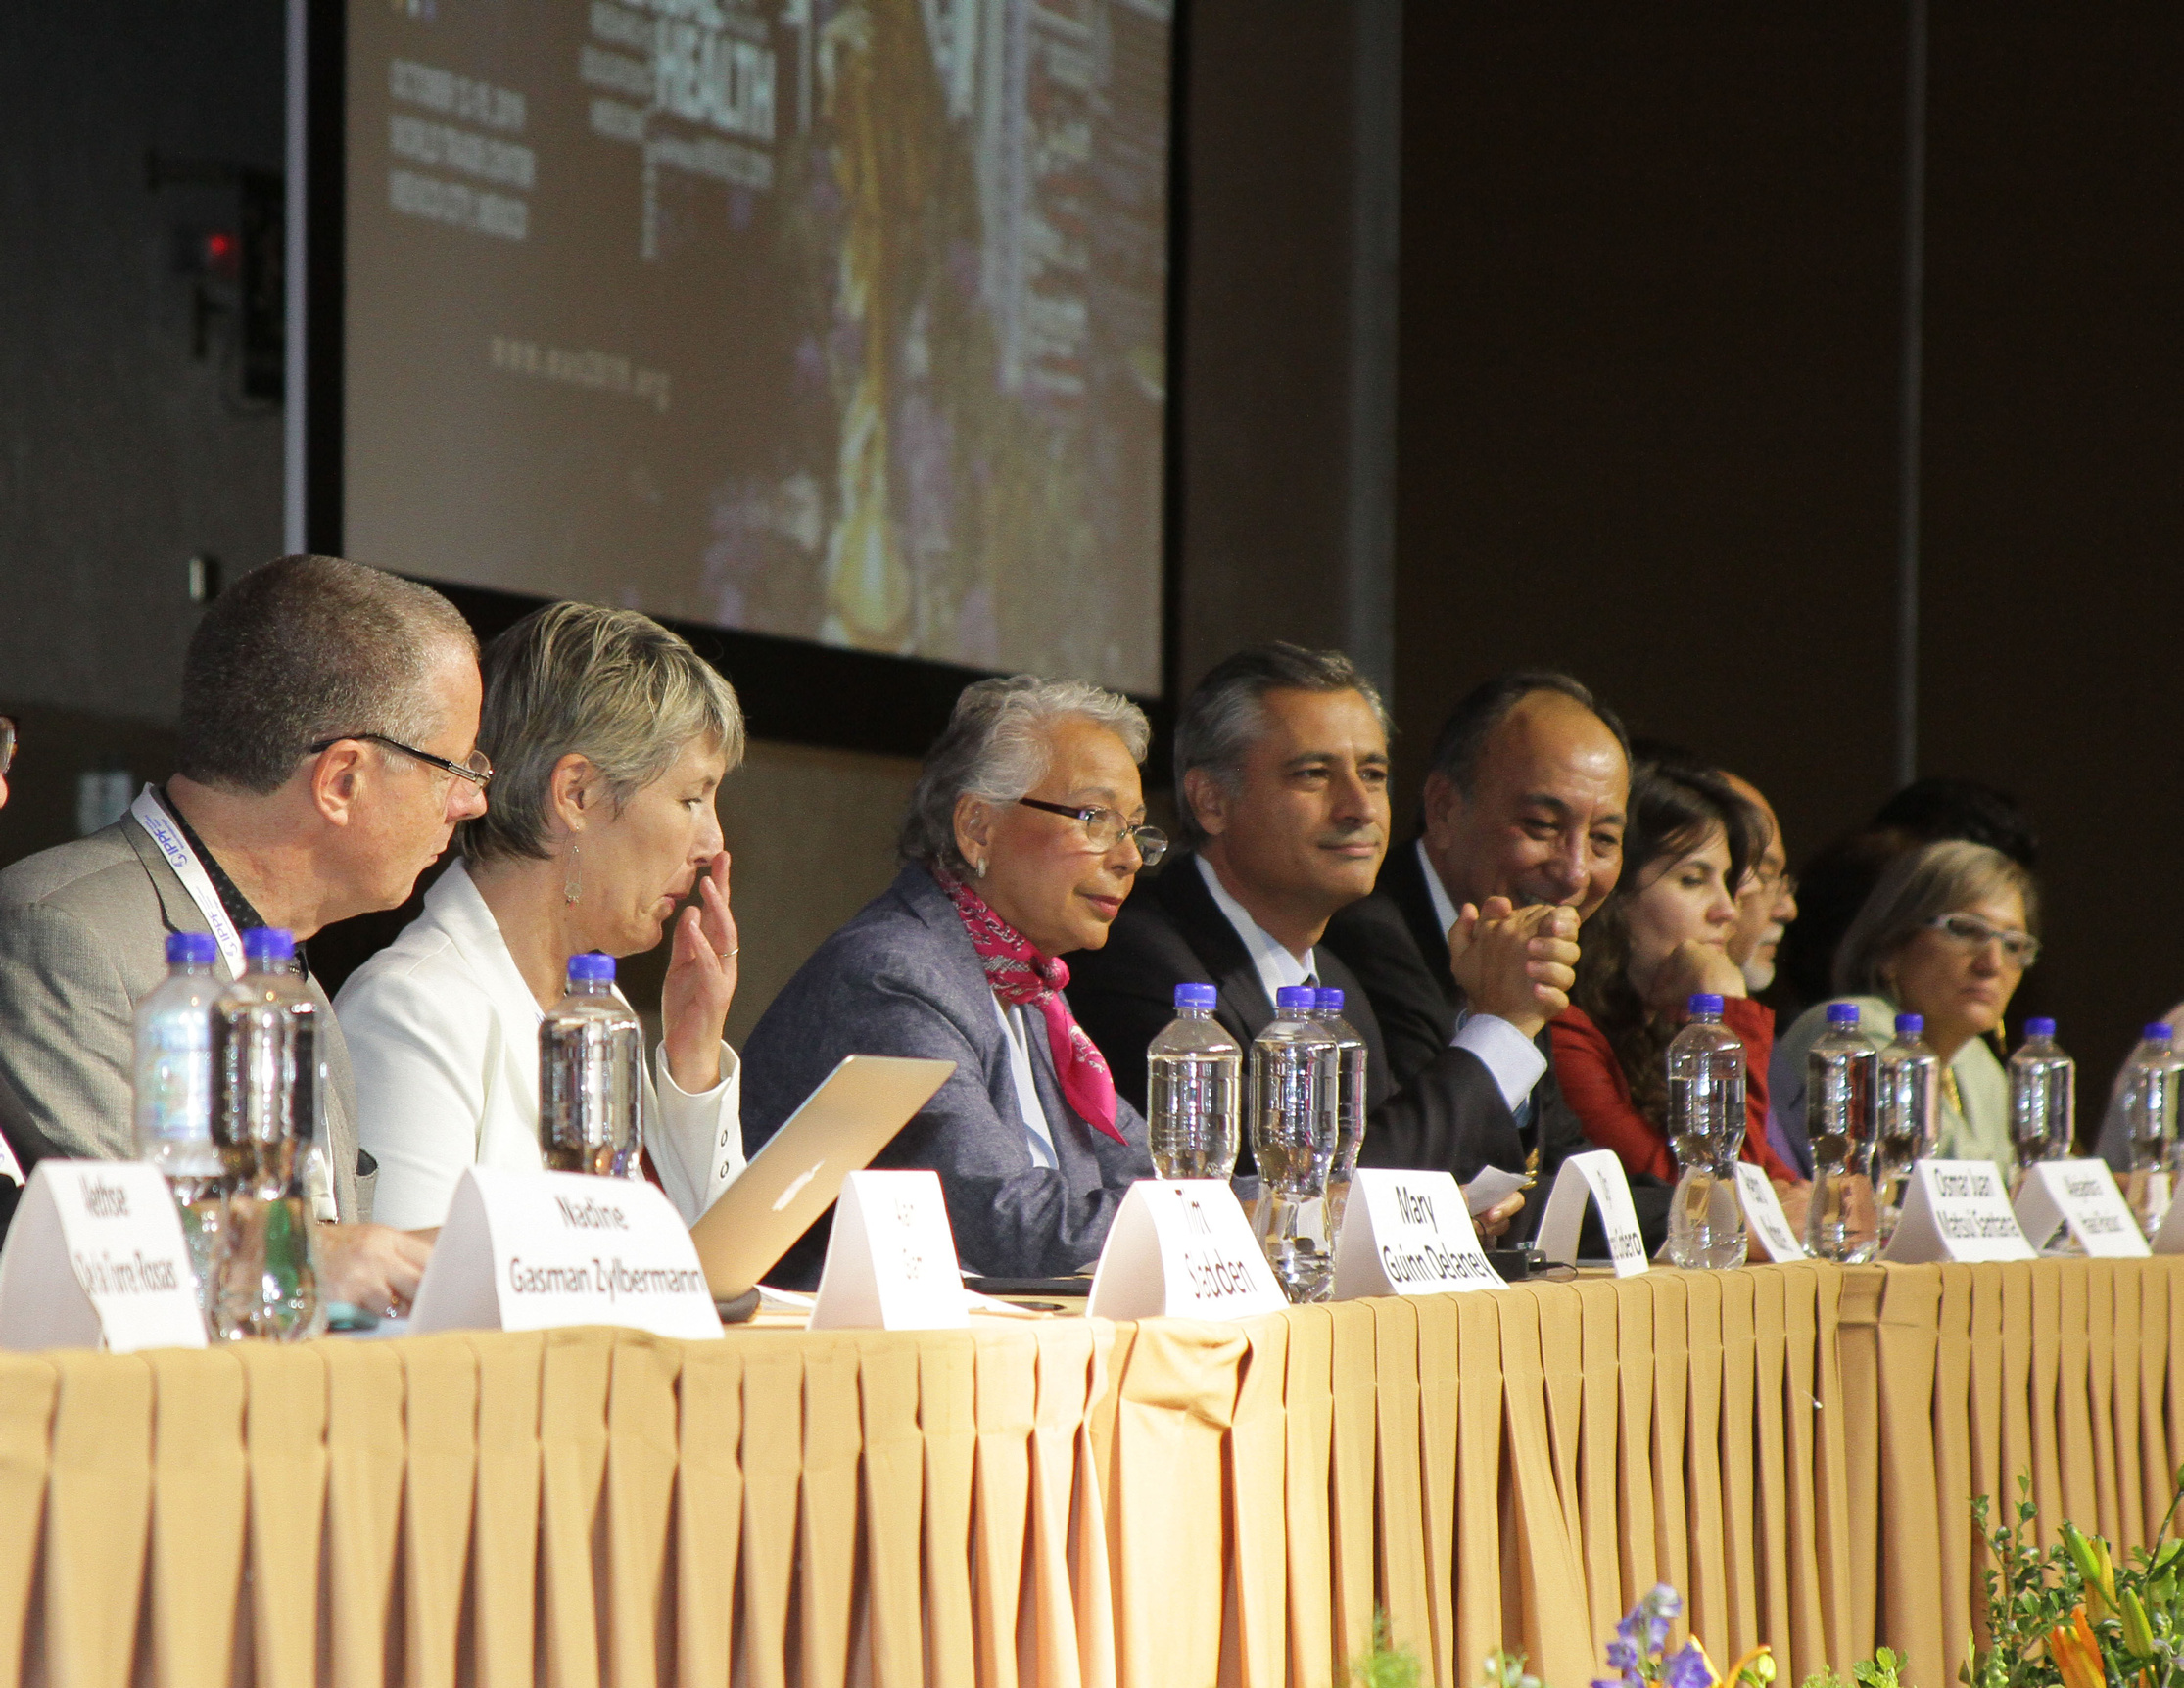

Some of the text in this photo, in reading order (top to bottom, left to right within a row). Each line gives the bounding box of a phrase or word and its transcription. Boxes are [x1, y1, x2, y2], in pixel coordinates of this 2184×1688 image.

[153, 829, 180, 856] IPPF
[207, 911, 230, 942] IPPF
[555, 1195, 629, 1231] Nadine
[1174, 1187, 1211, 1235] Tim
[1395, 1185, 1439, 1234] Mary
[509, 1256, 707, 1305] Gasman Zylbermann
[1382, 1241, 1500, 1285] Guinn Delaney
